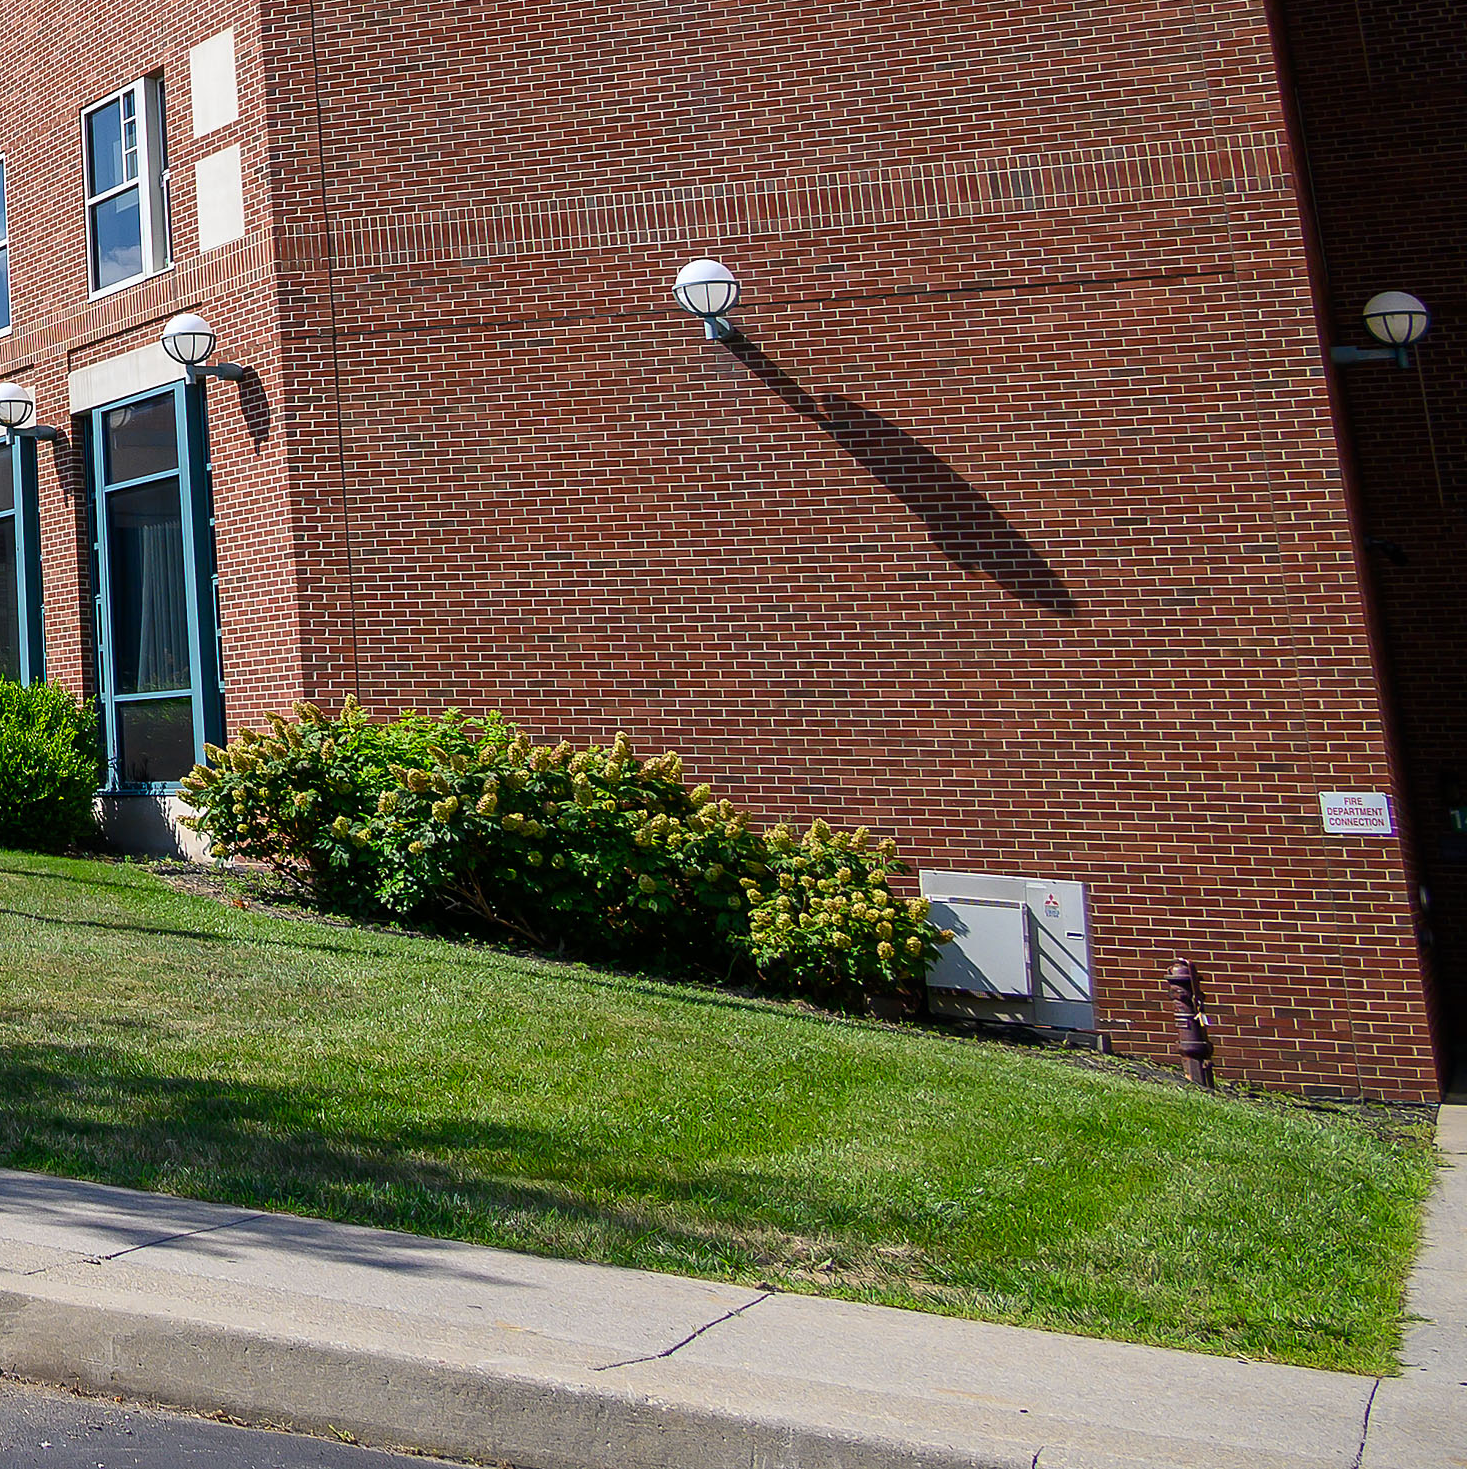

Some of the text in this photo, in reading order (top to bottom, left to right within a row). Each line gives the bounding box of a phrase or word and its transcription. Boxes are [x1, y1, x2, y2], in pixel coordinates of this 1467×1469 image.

[1344, 797, 1363, 806] FIRE
[1327, 807, 1383, 816] DEPARTMENT
[1329, 818, 1385, 826] CONNECTION
